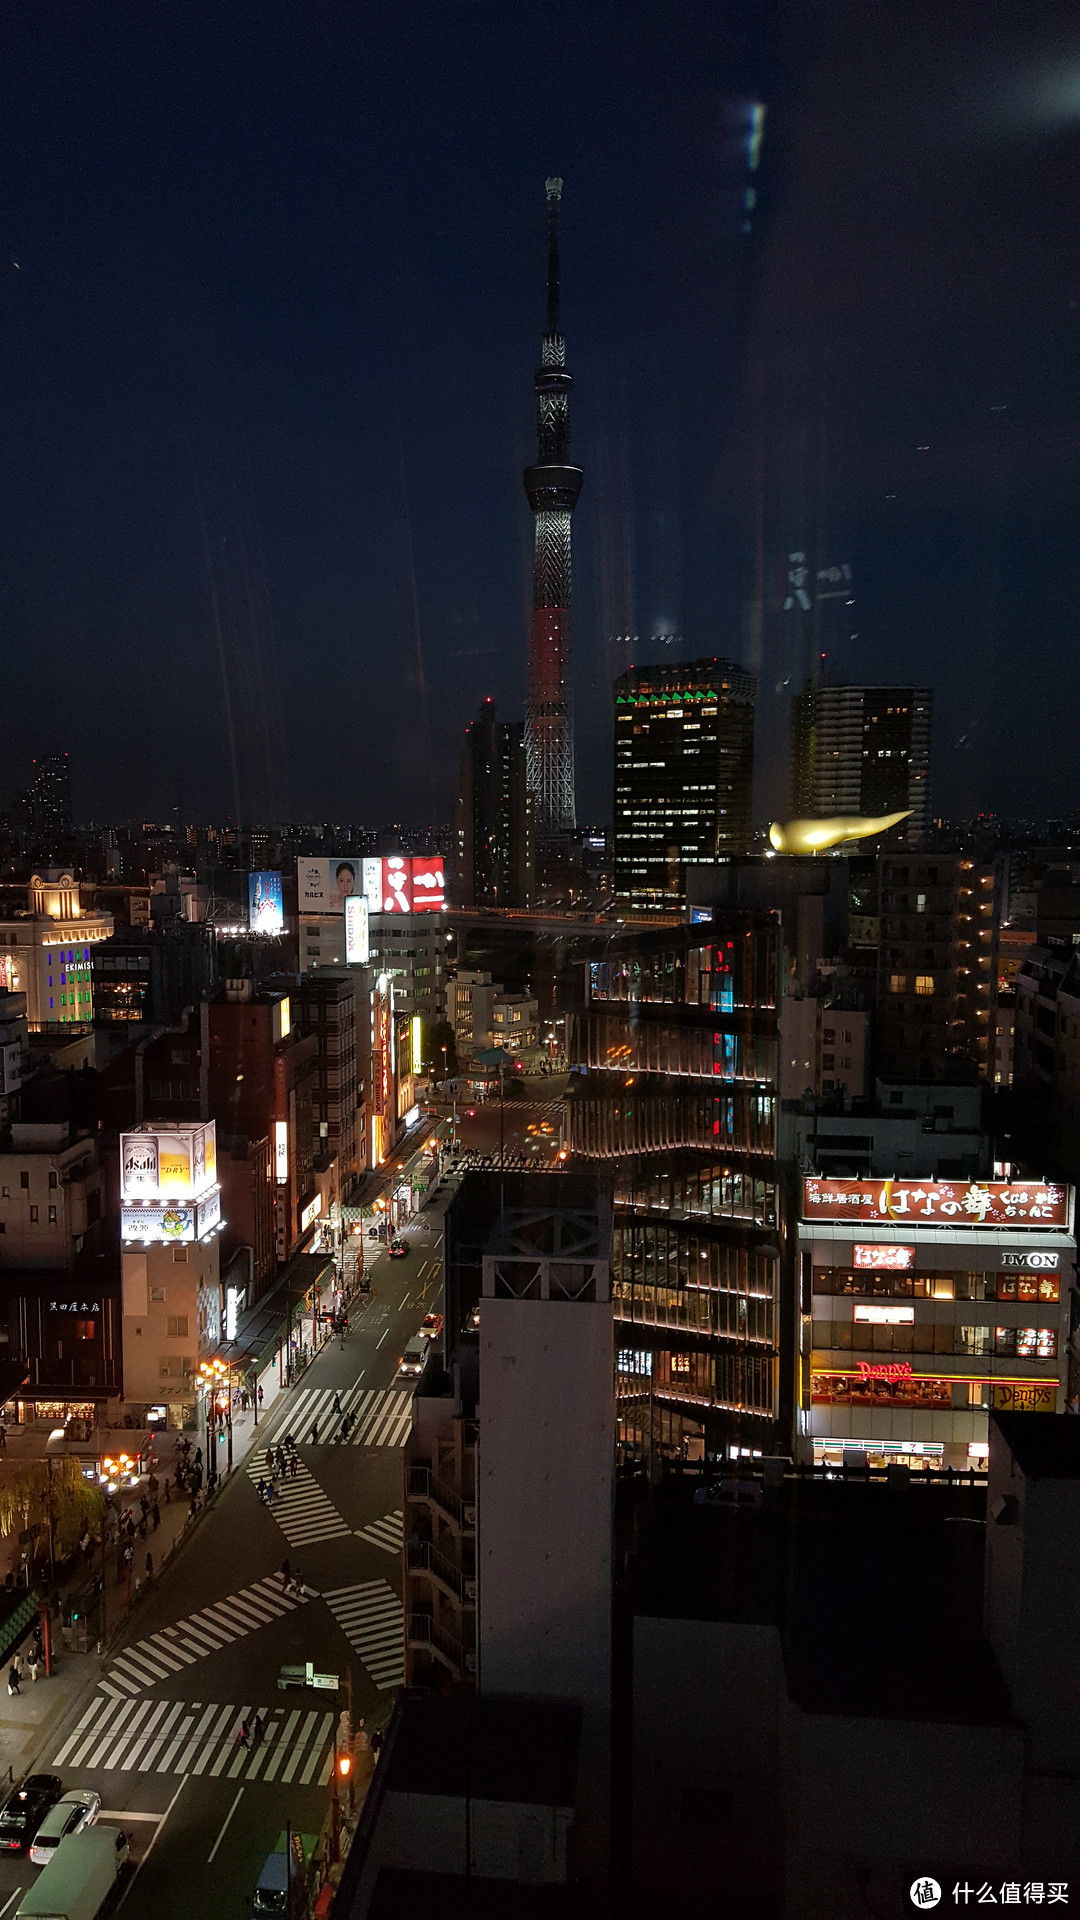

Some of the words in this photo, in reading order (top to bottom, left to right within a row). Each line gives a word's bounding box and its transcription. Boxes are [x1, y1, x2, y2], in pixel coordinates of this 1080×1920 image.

[125, 1156, 156, 1171] Asahi
[808, 1191, 874, 1206] 海鮮居酒屋
[879, 1184, 995, 1222] はなの舞
[1004, 1204, 1054, 1218] ちゃんこ
[1002, 1252, 1059, 1268] IMON
[856, 1361, 913, 1383] Denny's
[998, 1386, 1052, 1405] Denny's
